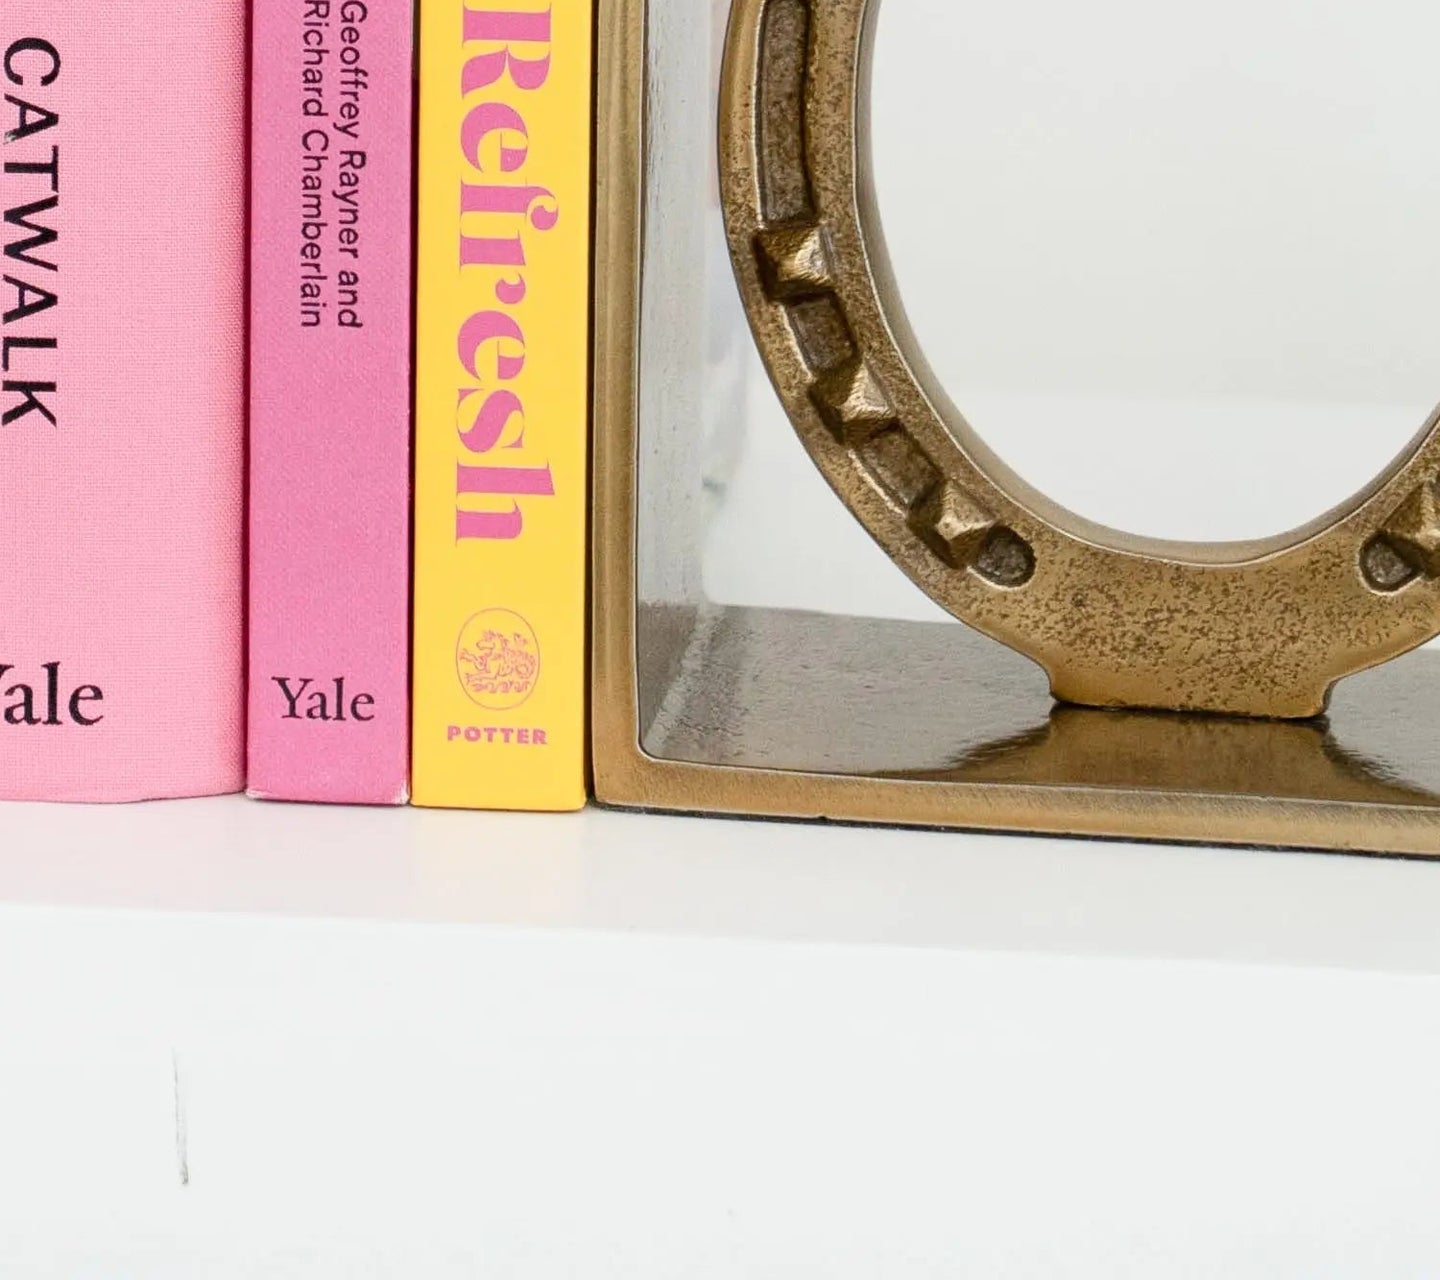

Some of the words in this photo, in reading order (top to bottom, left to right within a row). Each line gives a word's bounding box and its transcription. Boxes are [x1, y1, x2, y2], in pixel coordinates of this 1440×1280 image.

[302, 0, 331, 117] Richard
[333, 0, 369, 139] Geoffrey
[1, 37, 62, 427] CATWALK
[300, 129, 329, 328] Chamberlain
[332, 149, 367, 259] Rayner
[337, 270, 364, 328] and
[272, 676, 375, 721] Yale
[447, 725, 547, 745] POTTER
